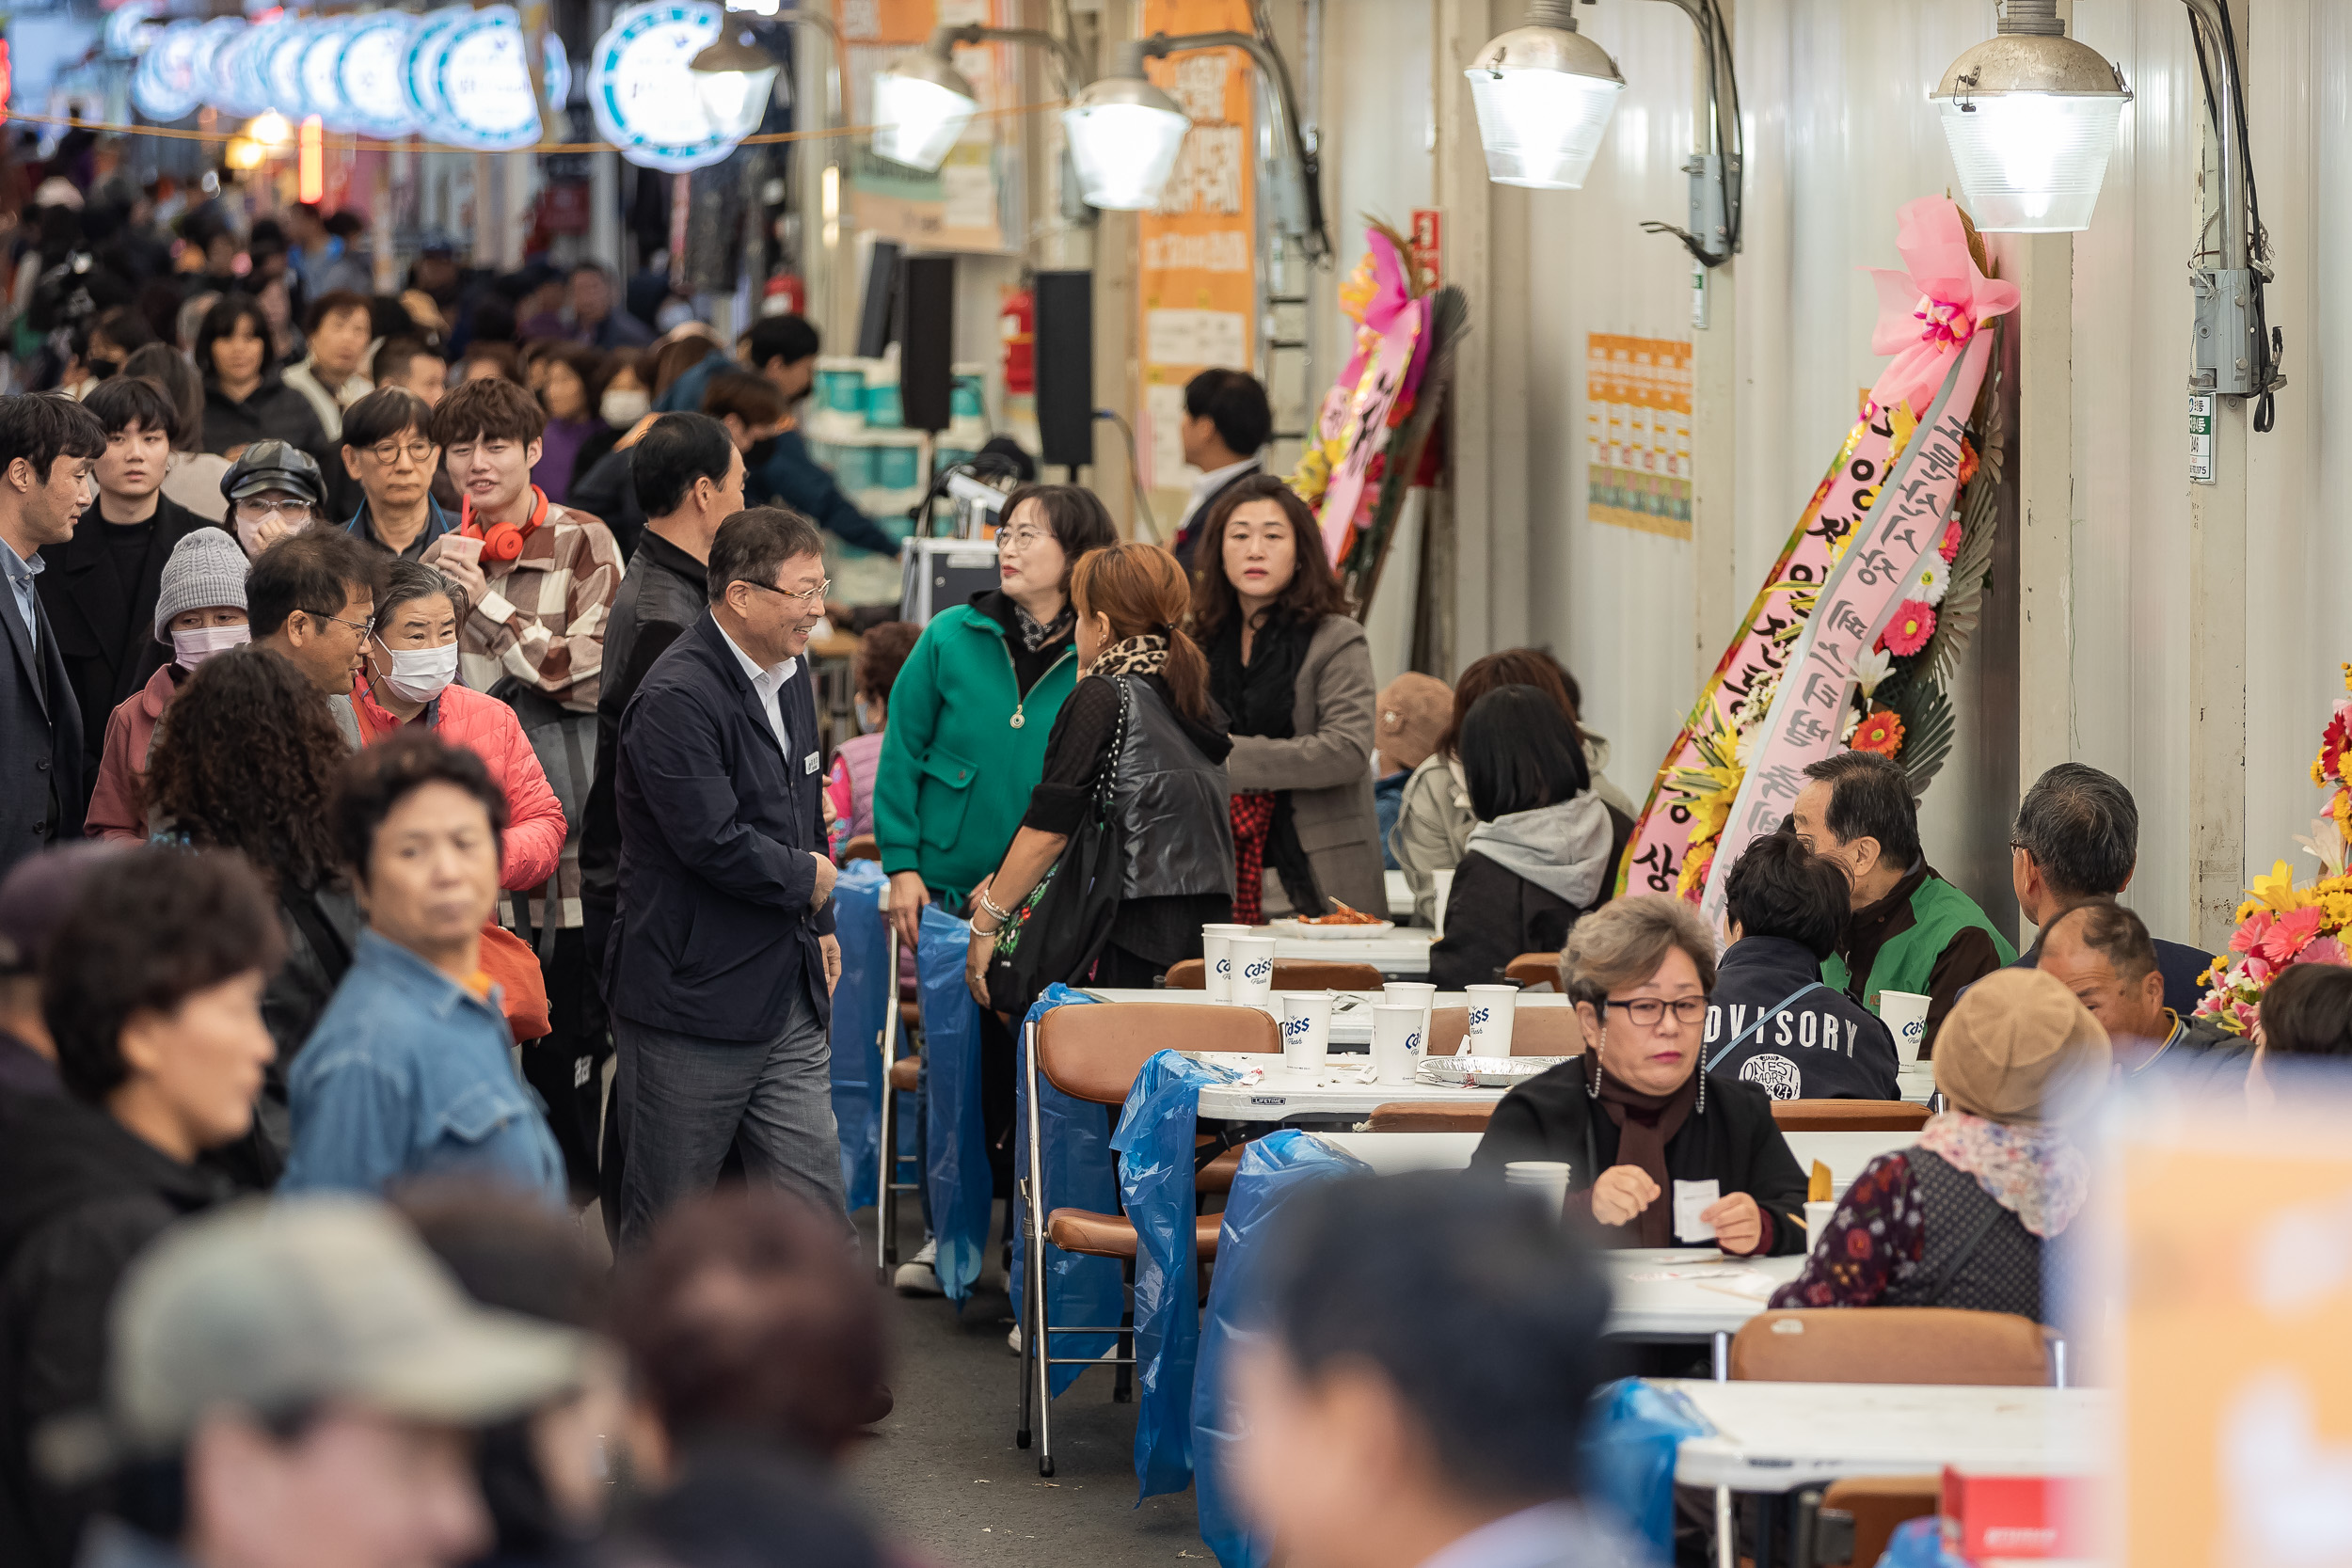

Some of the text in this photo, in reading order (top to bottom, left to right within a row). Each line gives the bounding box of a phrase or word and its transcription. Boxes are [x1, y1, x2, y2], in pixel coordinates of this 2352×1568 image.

[1216, 958, 1231, 974] Ca
[1470, 1007, 1489, 1026] ass
[1902, 1020, 1925, 1037] Cas
[1406, 1030, 1422, 1050] Ca
